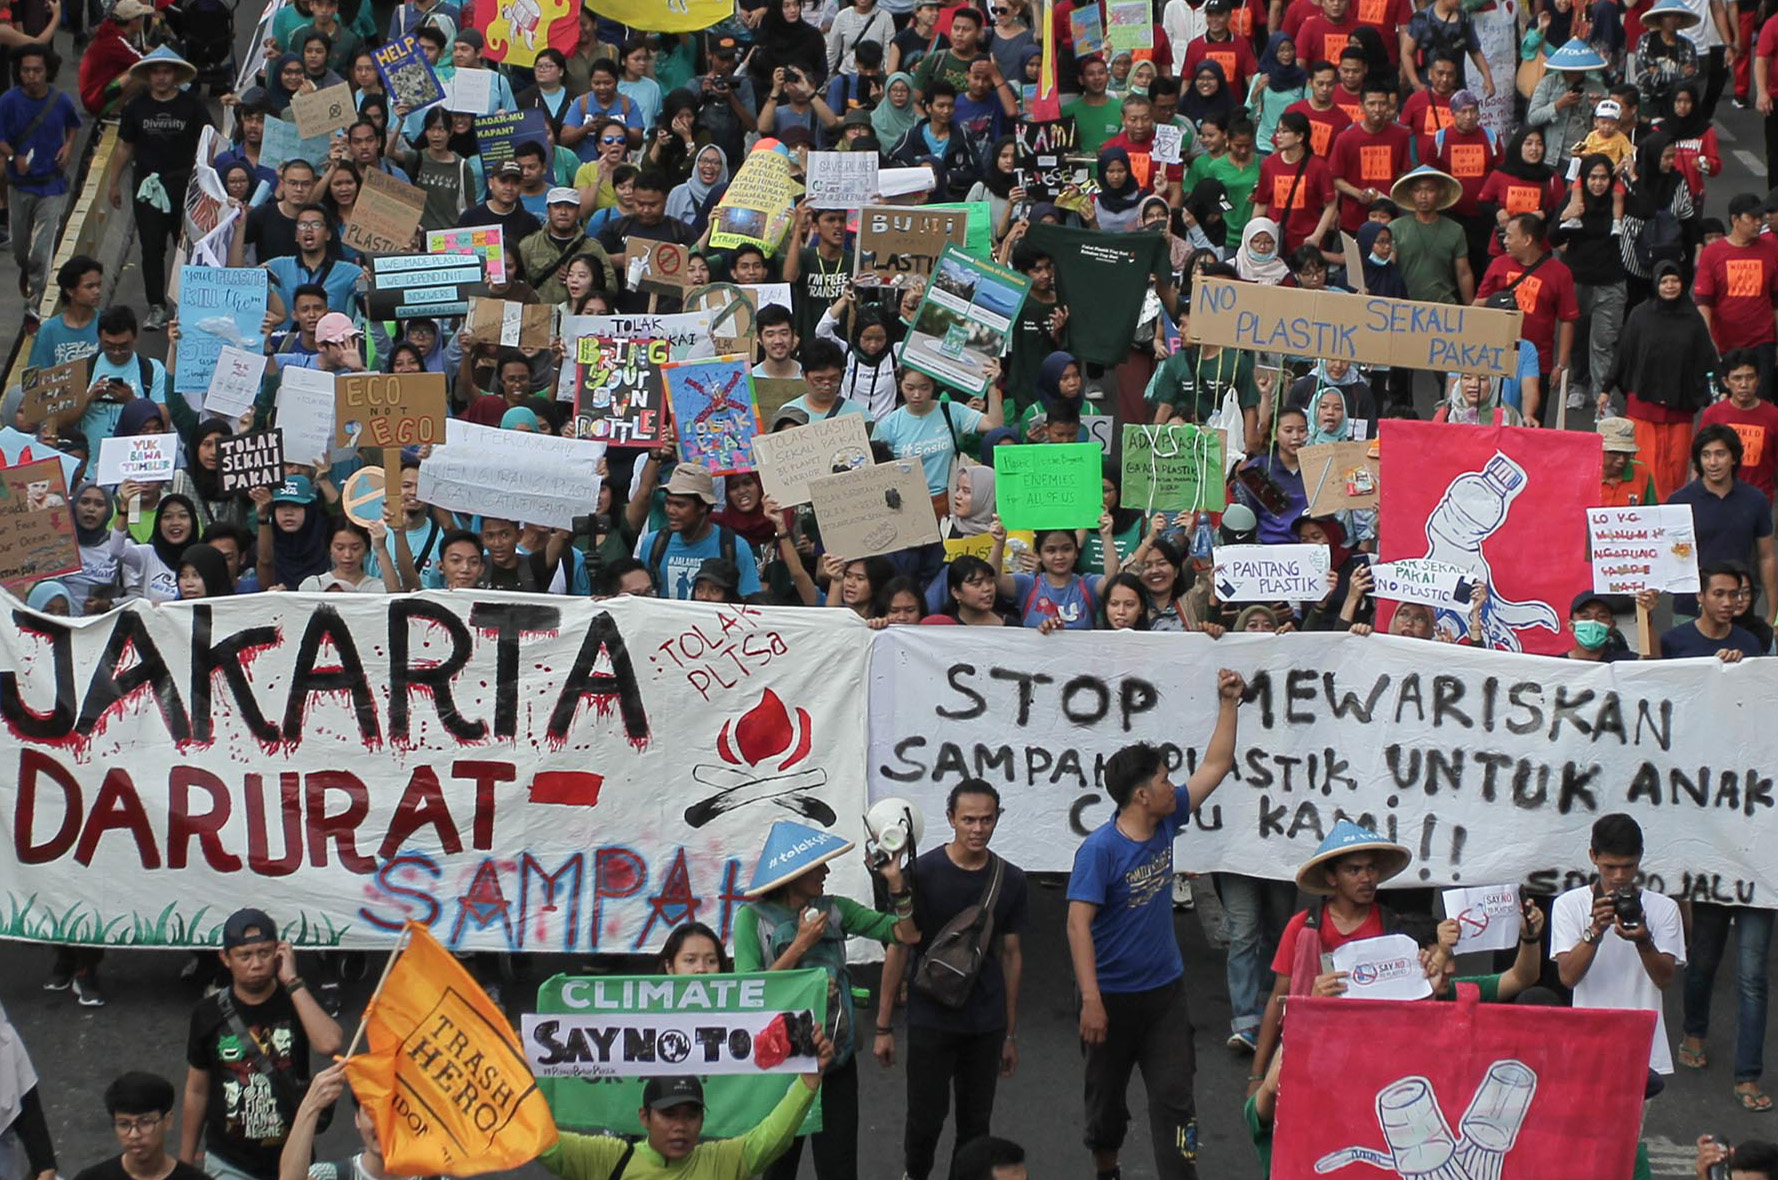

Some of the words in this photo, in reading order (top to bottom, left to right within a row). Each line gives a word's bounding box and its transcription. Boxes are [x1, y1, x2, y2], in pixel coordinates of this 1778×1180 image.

[375, 36, 415, 67] HELP
[142, 119, 187, 131] Diversity
[474, 112, 525, 127] SADAR-MU
[476, 126, 515, 139] KAPAN?
[1015, 119, 1075, 158] KAMI
[347, 223, 408, 252] PLASTI
[383, 260, 399, 269] WE
[404, 257, 431, 268] MADE
[432, 254, 468, 266] PLASTIC
[860, 250, 939, 274] PLASTI
[215, 270, 266, 286] PLASTIC
[385, 275, 400, 285] WE
[406, 272, 439, 284] DEPEND
[807, 272, 823, 285] I'M
[184, 287, 220, 309] KILL
[408, 291, 428, 301] NOW
[610, 317, 664, 333] TOLAK
[1200, 284, 1237, 313] NO
[1236, 311, 1358, 358] PLASTIK
[1366, 300, 1463, 333] SEKALI
[1430, 338, 1505, 370] PAKAI
[179, 331, 223, 362] STO
[577, 337, 668, 371] BRING
[346, 375, 401, 407] ECO
[592, 387, 649, 417] OWN
[370, 407, 408, 416] NOT
[369, 415, 434, 446] EGO
[575, 409, 657, 444] BOTTLE
[133, 439, 158, 450] YUK
[220, 432, 279, 455] TOLAK
[766, 430, 809, 450] TOLAK
[130, 450, 162, 461] BAWA
[222, 448, 280, 472] SEKALI
[223, 468, 281, 491] PAKAI
[1024, 473, 1077, 487] ENEMIES
[1027, 493, 1042, 505] ALL
[1062, 491, 1075, 504] US
[1592, 514, 1609, 524] LO
[1233, 560, 1299, 578] PANTANG
[1395, 566, 1436, 584] PAKAI
[1260, 577, 1319, 594] PLASTIK
[1402, 584, 1451, 602] PLASTIC
[659, 603, 761, 669] TOLAK
[0, 599, 650, 748] JAKARTA
[686, 629, 788, 702] PLTSa
[935, 662, 1161, 733] STOP
[1384, 743, 1602, 815] UNTUK
[1627, 761, 1776, 816] ANAK
[15, 747, 517, 877] DARURAT
[1486, 894, 1501, 905] SAY
[1501, 893, 1513, 904] NO
[1681, 872, 1756, 905] JALU
[1378, 962, 1393, 974] SAY
[1394, 960, 1405, 970] NO
[561, 978, 767, 1009] CLIMATE
[533, 1020, 621, 1065] SAY
[623, 1027, 691, 1063] NO
[695, 1026, 751, 1062] TO
[430, 1014, 515, 1110] TRASH
[407, 1036, 499, 1132] HERO
